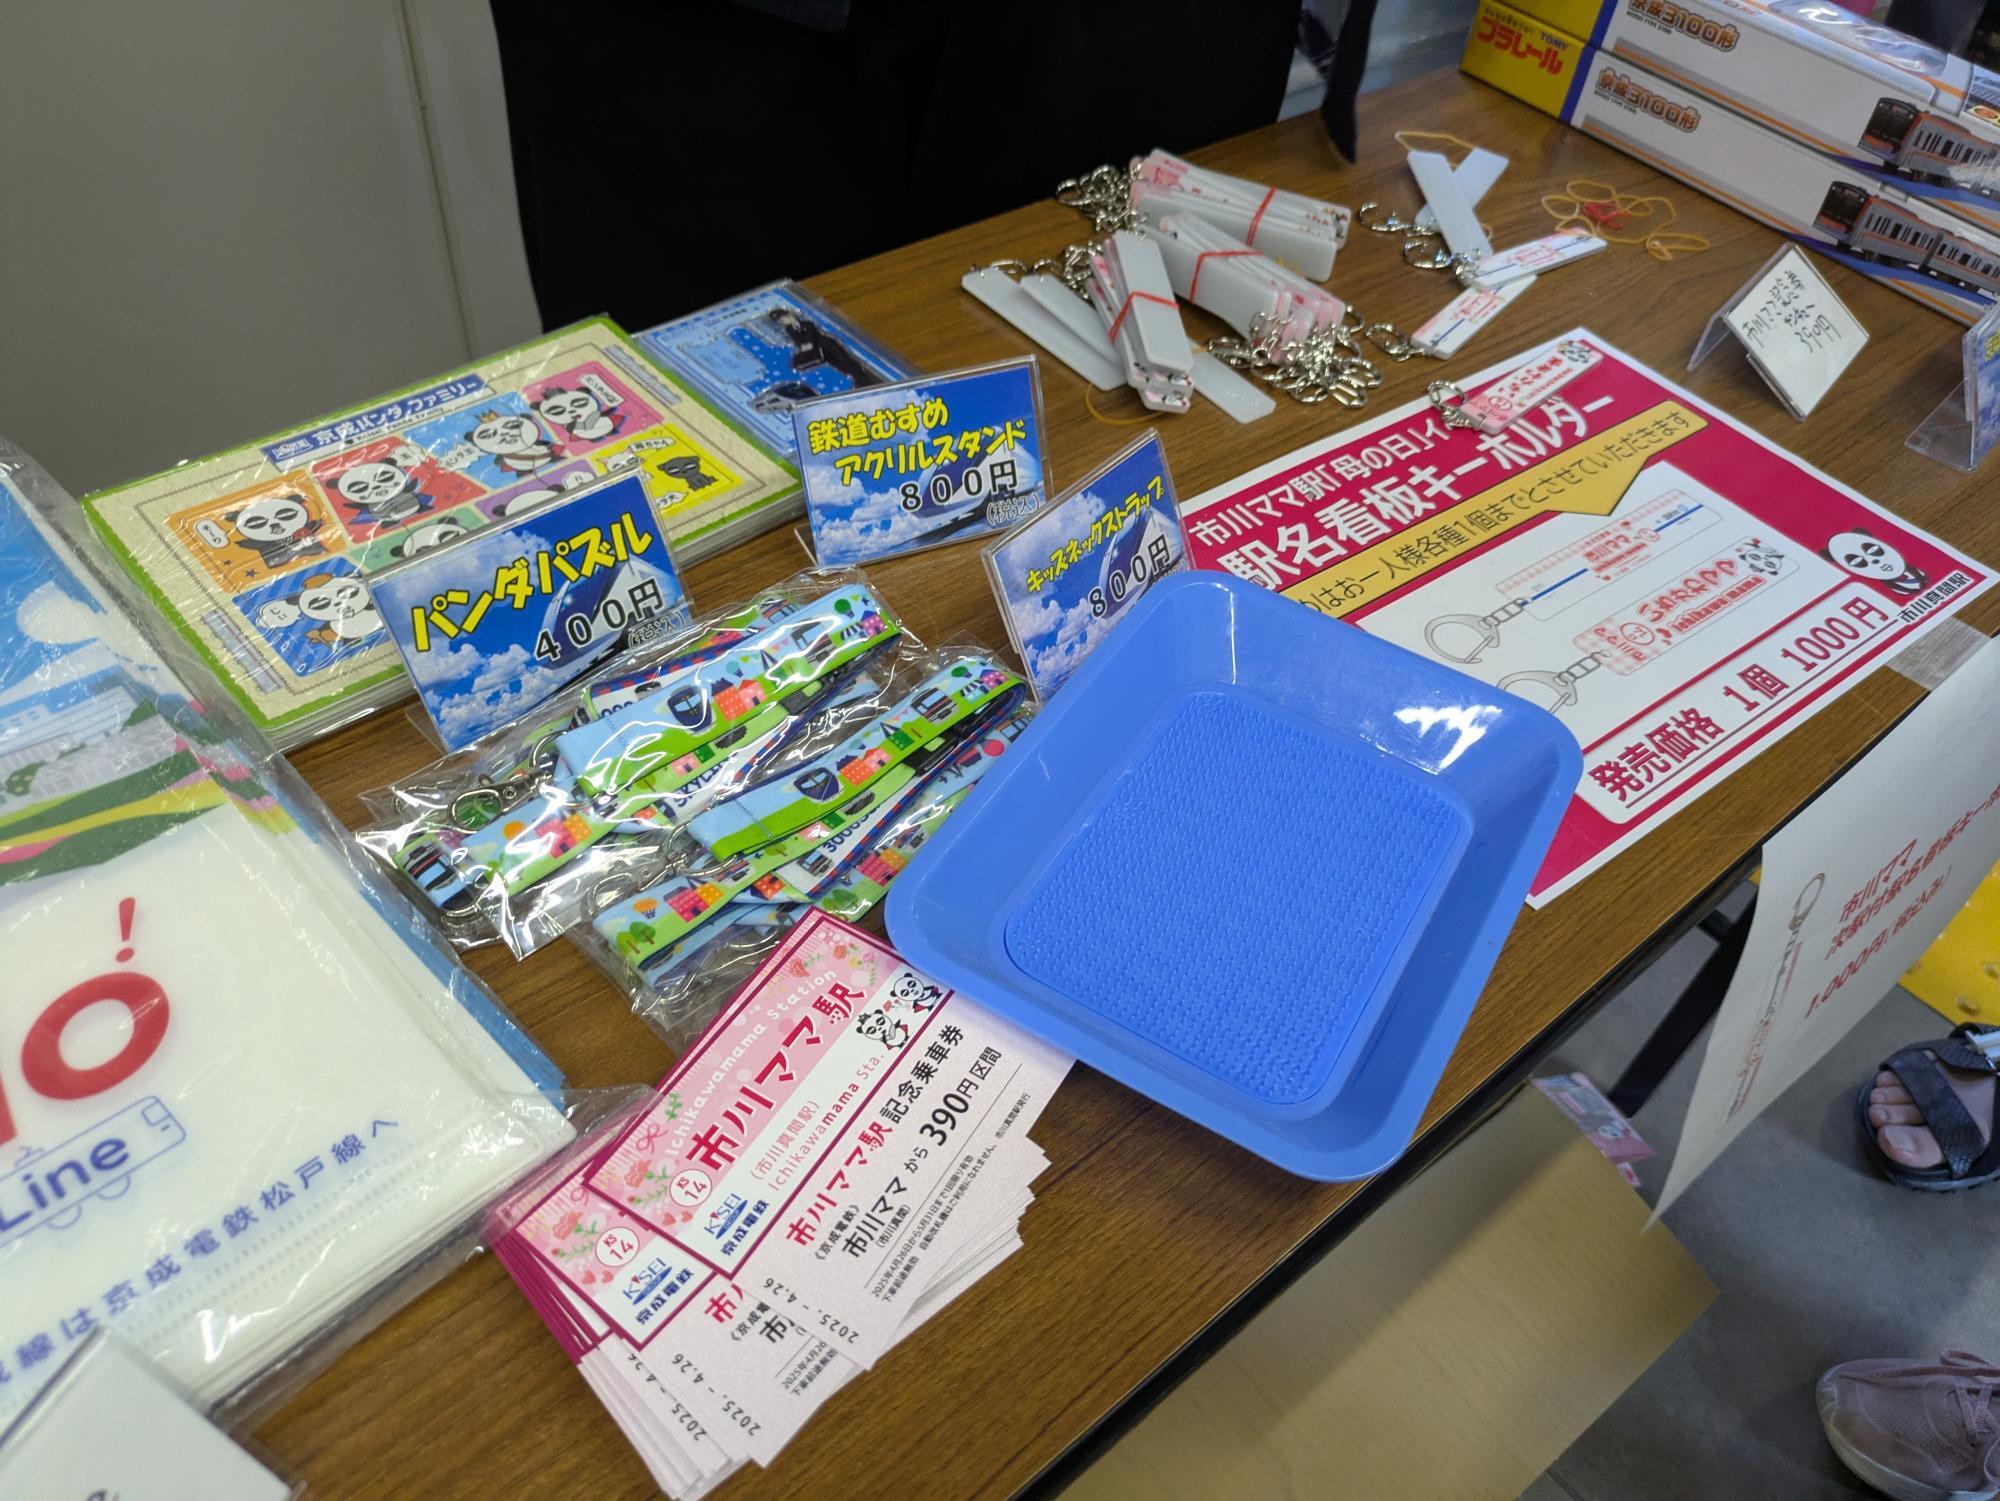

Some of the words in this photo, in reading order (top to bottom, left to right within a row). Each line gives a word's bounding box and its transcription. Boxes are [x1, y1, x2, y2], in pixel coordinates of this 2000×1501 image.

[1476, 15, 1563, 75] プラレール
[807, 397, 950, 455] 鉄道むすめ
[835, 420, 1027, 486] アクリルスタンド
[900, 459, 1018, 513] 800円
[1189, 417, 1453, 546] 市川ママ駅「母の日」イ
[1217, 396, 1613, 592] 駅名看板キーホルダー
[1026, 475, 1164, 593] キッズネックストラップ
[411, 512, 652, 652] パンダパズル
[1089, 534, 1170, 618] 800円
[1898, 573, 1971, 624] 市川真間駅
[534, 577, 663, 662] 400円
[1589, 707, 1725, 801] 発売価格
[1723, 663, 1790, 712] 1個
[1839, 838, 1917, 923] 市川ママ
[766, 969, 838, 1021] Station
[686, 982, 865, 1171] 市川ママ駅
[751, 1100, 820, 1180] (市川真間駅)
[768, 1083, 860, 1192] Ichikawamama
[856, 1053, 885, 1080] Sta.
[786, 1121, 893, 1246] 市川ママ駅
[880, 1024, 964, 1124] 記念乗車券
[676, 1176, 690, 1190] KS
[685, 1179, 708, 1200] 14
[842, 1176, 908, 1257] 市川ママ
[904, 1147, 929, 1174] から
[602, 1233, 618, 1248] KS
[610, 1239, 634, 1260] 14
[720, 1199, 770, 1256] 京成電鉄
[635, 1268, 694, 1324] 京成電鉄
